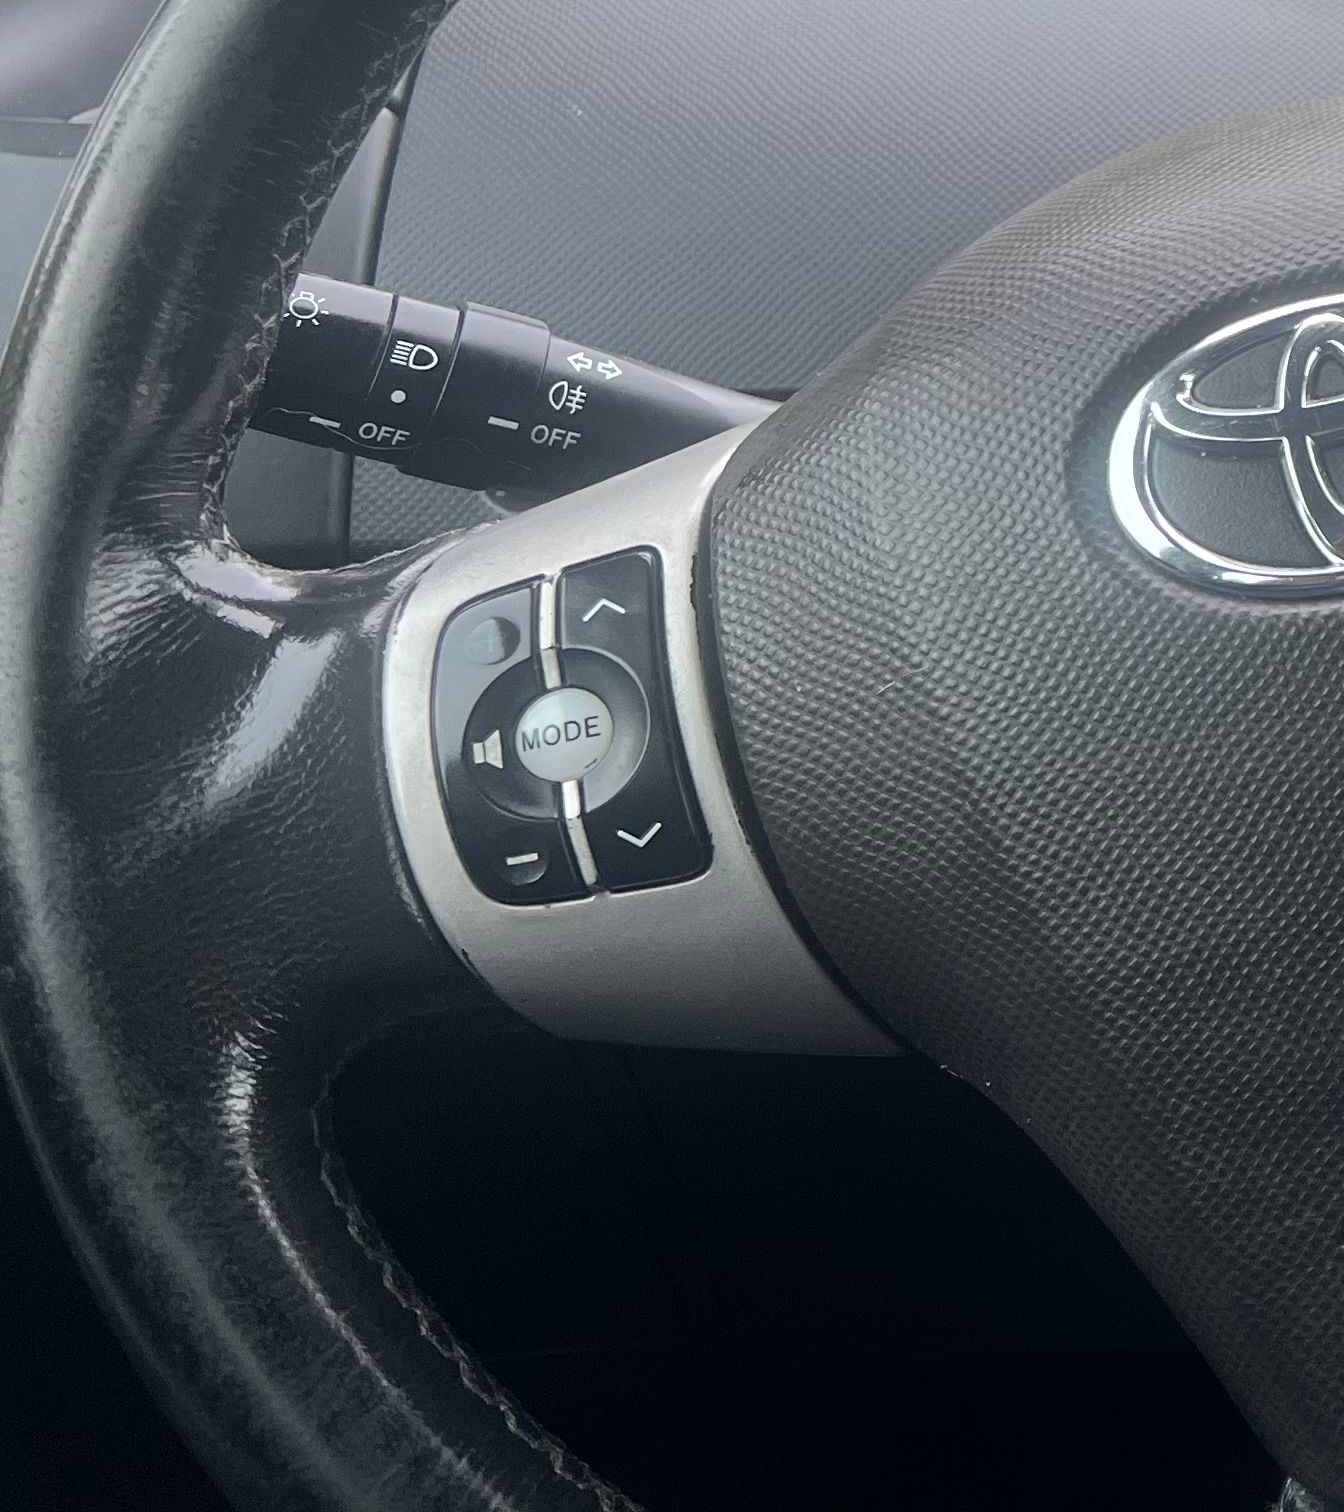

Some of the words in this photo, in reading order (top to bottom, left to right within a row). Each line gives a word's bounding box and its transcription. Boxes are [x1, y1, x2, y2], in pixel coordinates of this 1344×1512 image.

[358, 421, 410, 445] OFF
[531, 423, 581, 450] OFF
[521, 715, 601, 752] MODE
